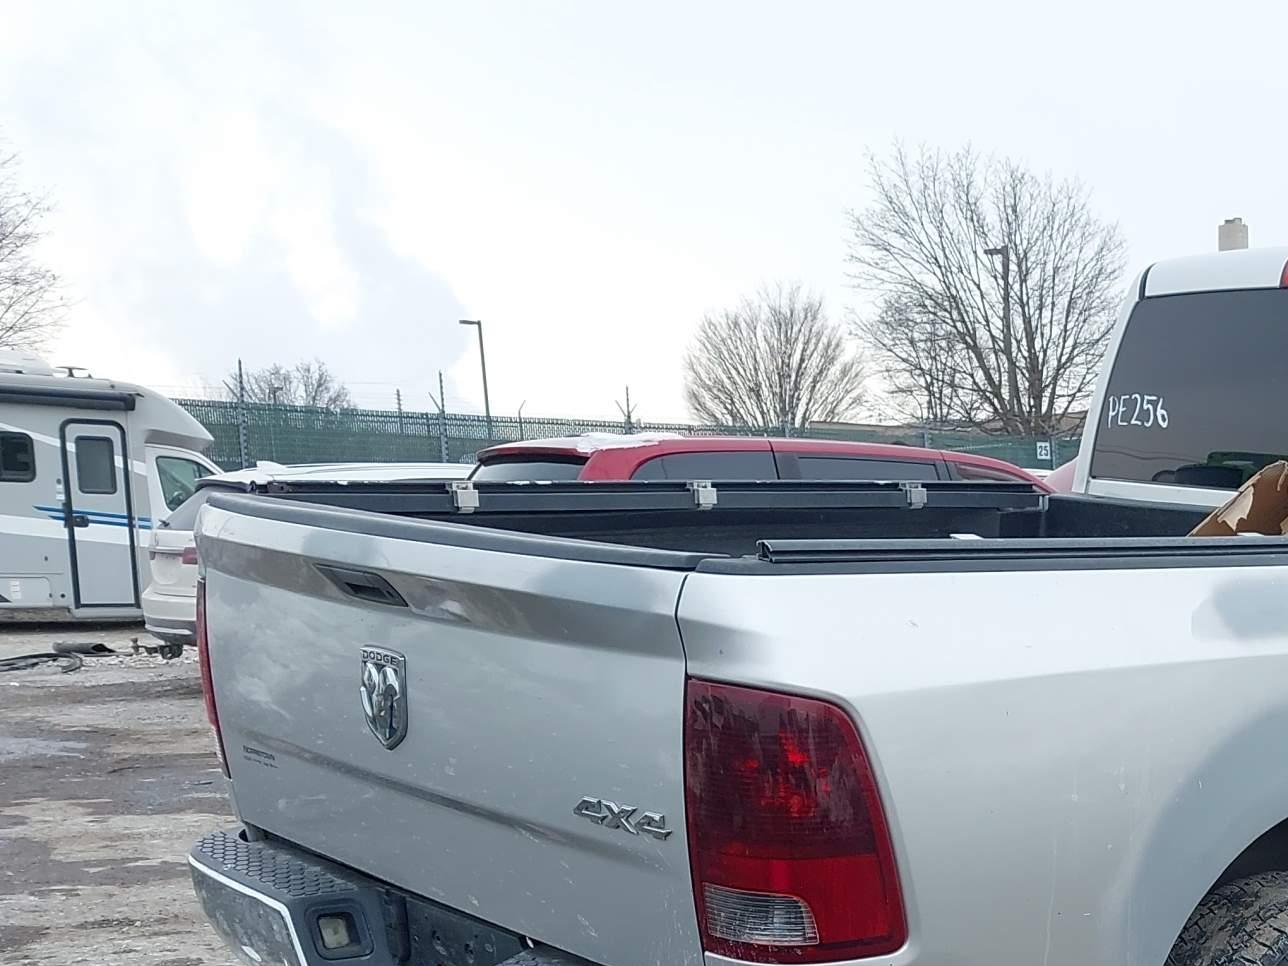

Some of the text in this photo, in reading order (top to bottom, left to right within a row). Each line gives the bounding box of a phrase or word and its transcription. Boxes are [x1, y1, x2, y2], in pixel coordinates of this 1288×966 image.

[1108, 394, 1169, 429] PE256
[1038, 445, 1049, 457] 25
[362, 650, 399, 665] DODGE
